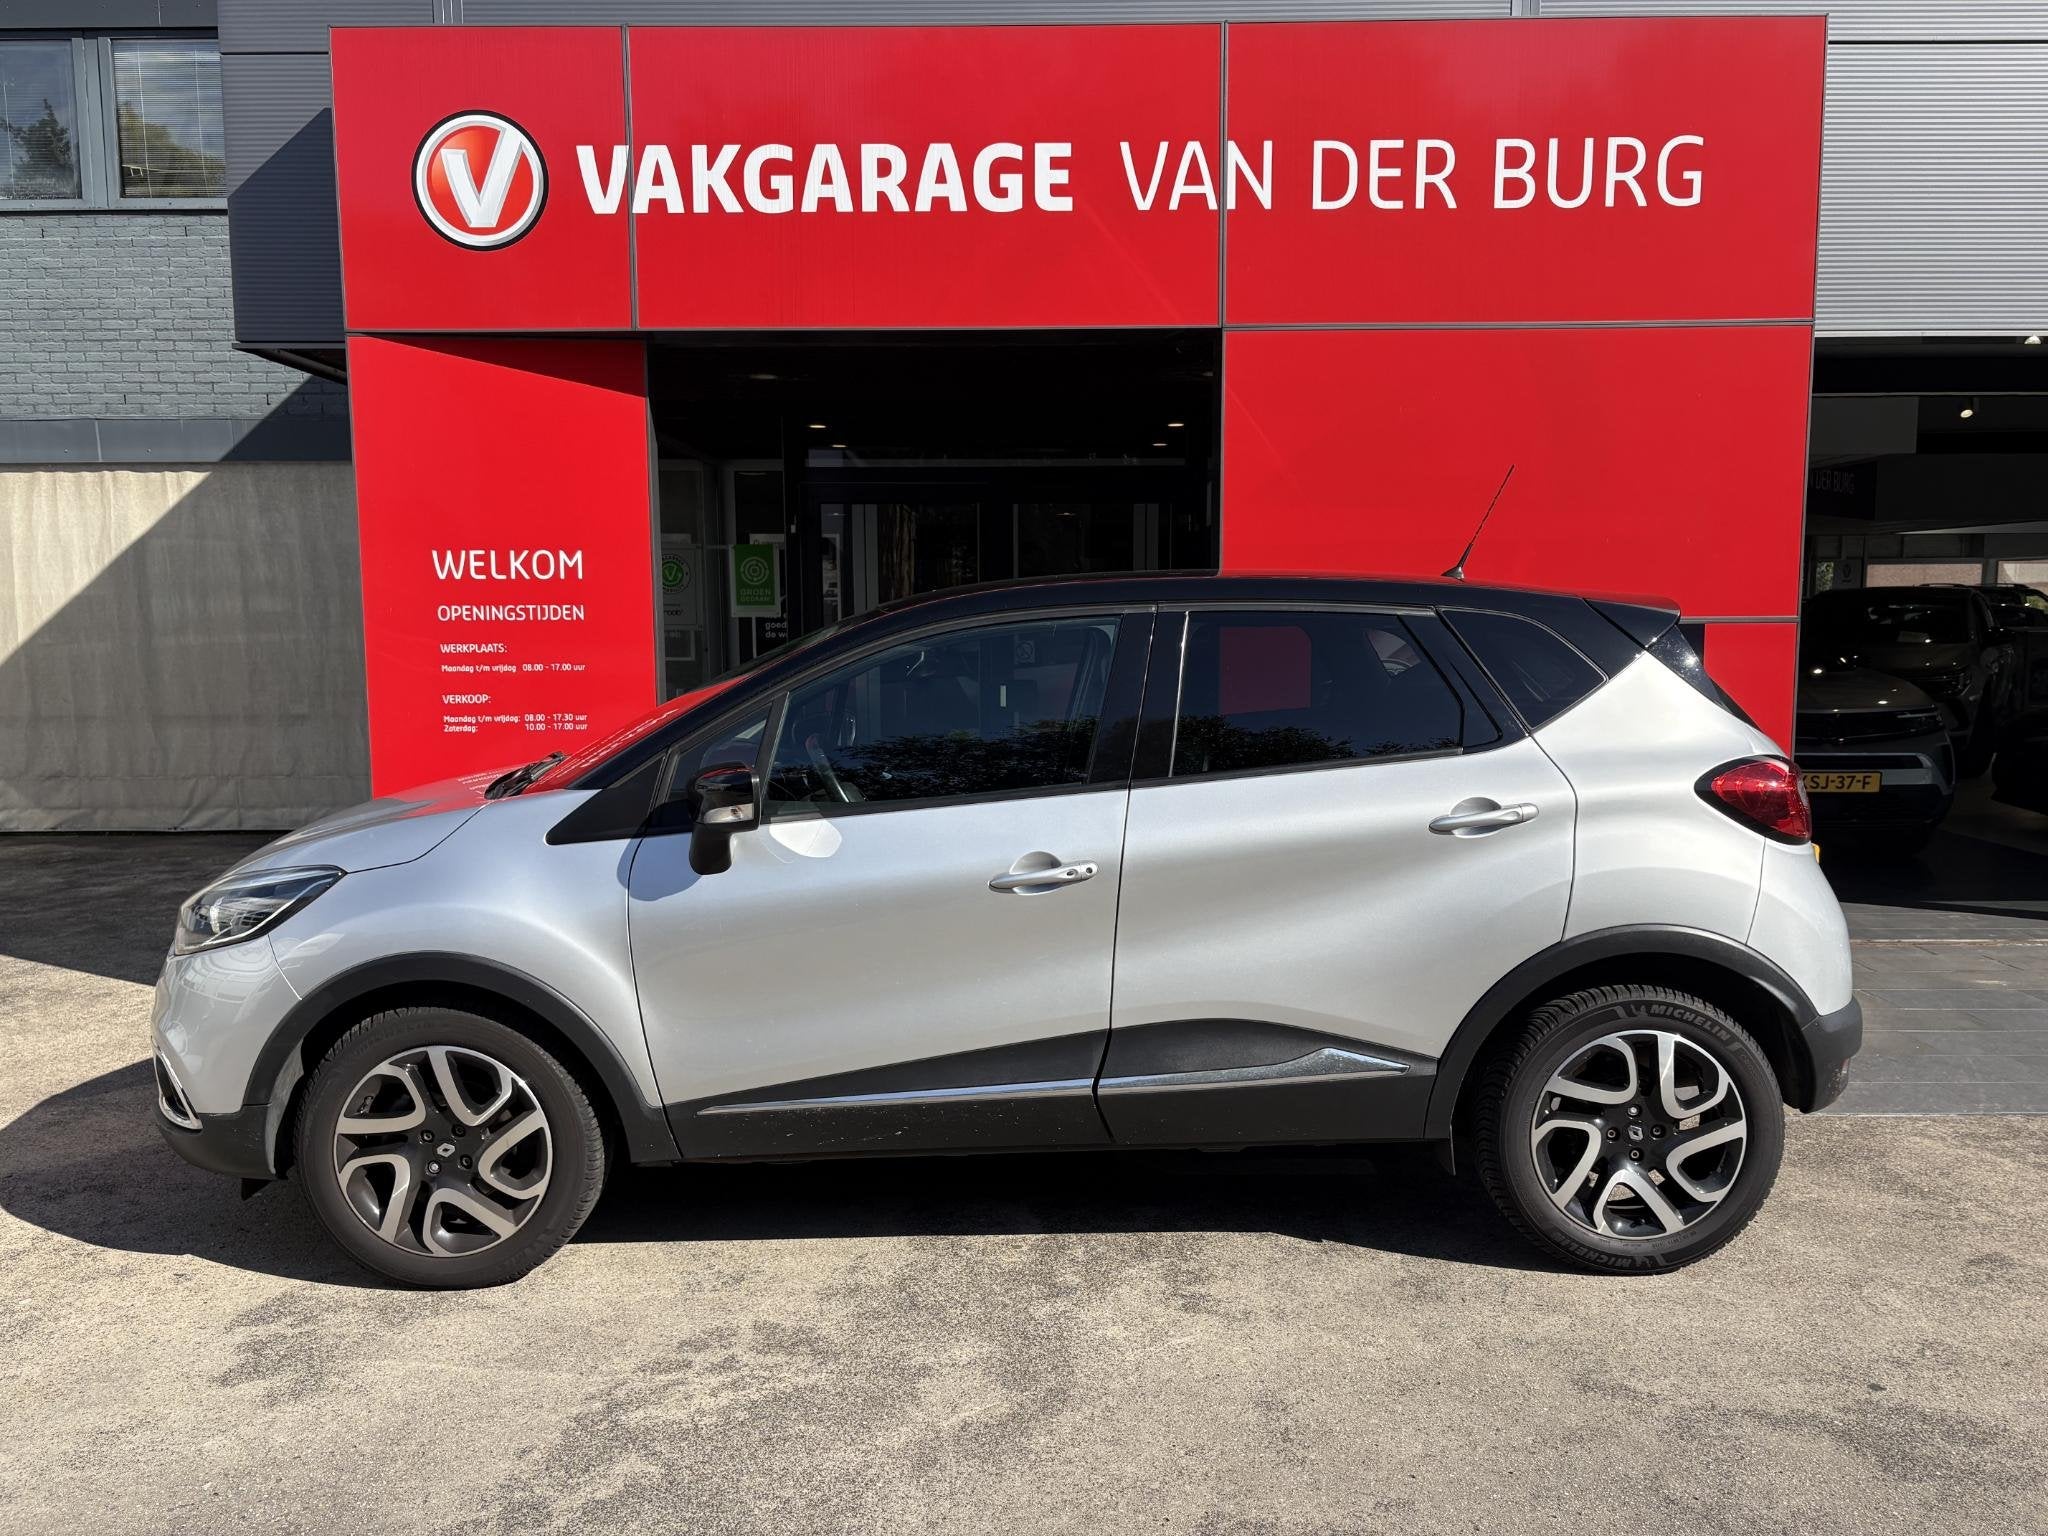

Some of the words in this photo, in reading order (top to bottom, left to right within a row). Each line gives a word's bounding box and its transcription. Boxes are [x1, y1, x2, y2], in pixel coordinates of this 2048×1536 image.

[576, 142, 1074, 215] VAKGARAGE
[1120, 140, 1273, 211] VAN
[1312, 139, 1457, 210] DER
[1493, 135, 1704, 209] BURG
[432, 550, 583, 580] WELKOM
[437, 604, 585, 621] OPENINGSTIJDEN
[440, 643, 508, 653] WERKPLAATS:
[441, 664, 474, 673] Maandag
[475, 664, 490, 672] t/m
[491, 664, 517, 673] vrijdag
[522, 663, 544, 672] 08.00
[551, 663, 572, 671] 17.00
[442, 694, 491, 704] VERKOOP:
[443, 715, 476, 724] Maandag
[477, 715, 492, 723] t/m
[493, 715, 521, 723] vrijdag:
[524, 713, 546, 722] 08.00
[552, 713, 574, 722] 17.30
[443, 724, 478, 733] Zaterdag:
[525, 723, 546, 731] 10.00
[553, 722, 574, 730] 17.00
[1650, 1004, 1731, 1041] MICHELIN
